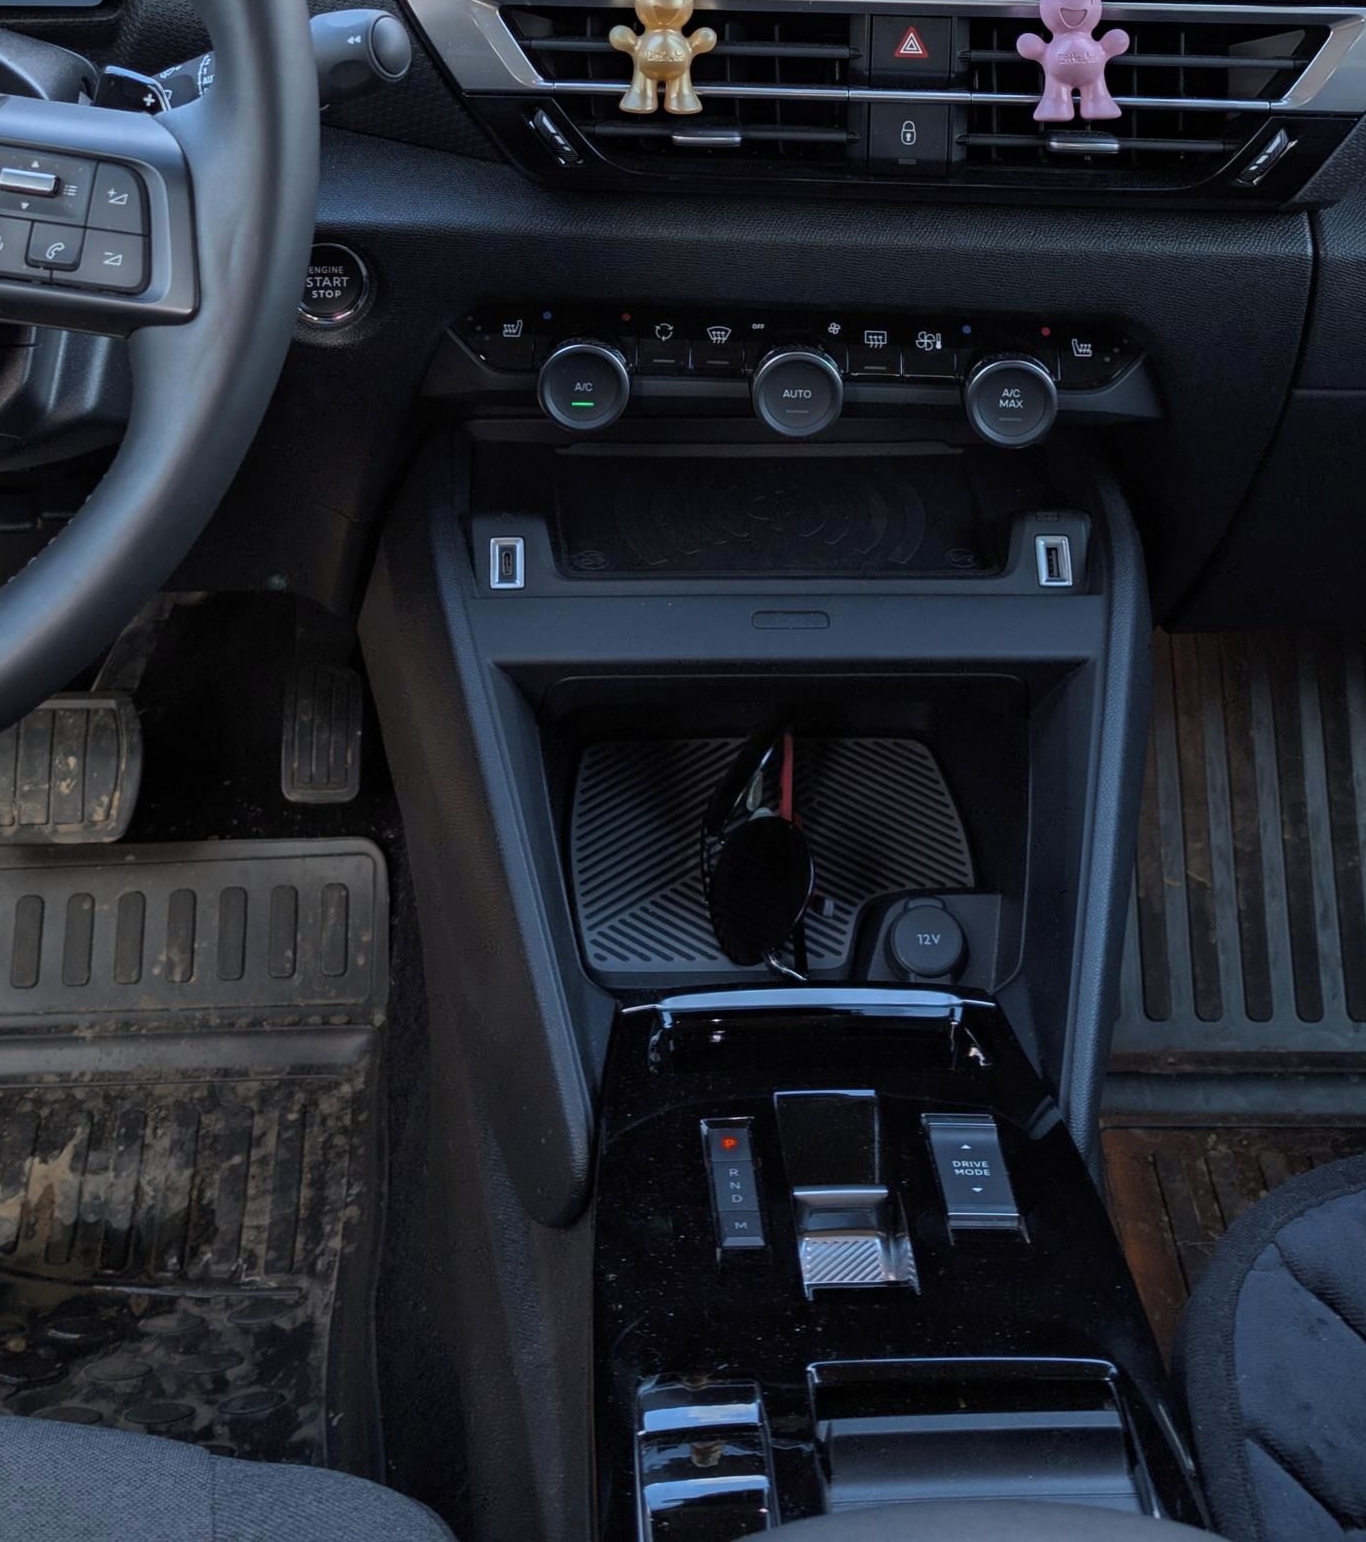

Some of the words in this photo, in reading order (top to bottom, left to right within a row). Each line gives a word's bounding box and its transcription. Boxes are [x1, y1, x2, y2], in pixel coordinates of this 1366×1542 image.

[308, 265, 344, 275] ENGINE
[306, 276, 351, 288] START
[311, 289, 342, 299] STOP
[574, 381, 594, 392] A/C
[782, 389, 812, 399] AUTO
[1001, 387, 1021, 398] A/C
[998, 398, 1024, 409] MAX
[916, 933, 941, 945] 12V
[723, 1138, 738, 1150] P
[952, 1160, 990, 1168] DRIVE
[728, 1168, 740, 1177] R
[954, 1168, 992, 1176] MODE
[730, 1181, 741, 1190] N
[731, 1194, 743, 1203] D
[734, 1221, 748, 1230] M
